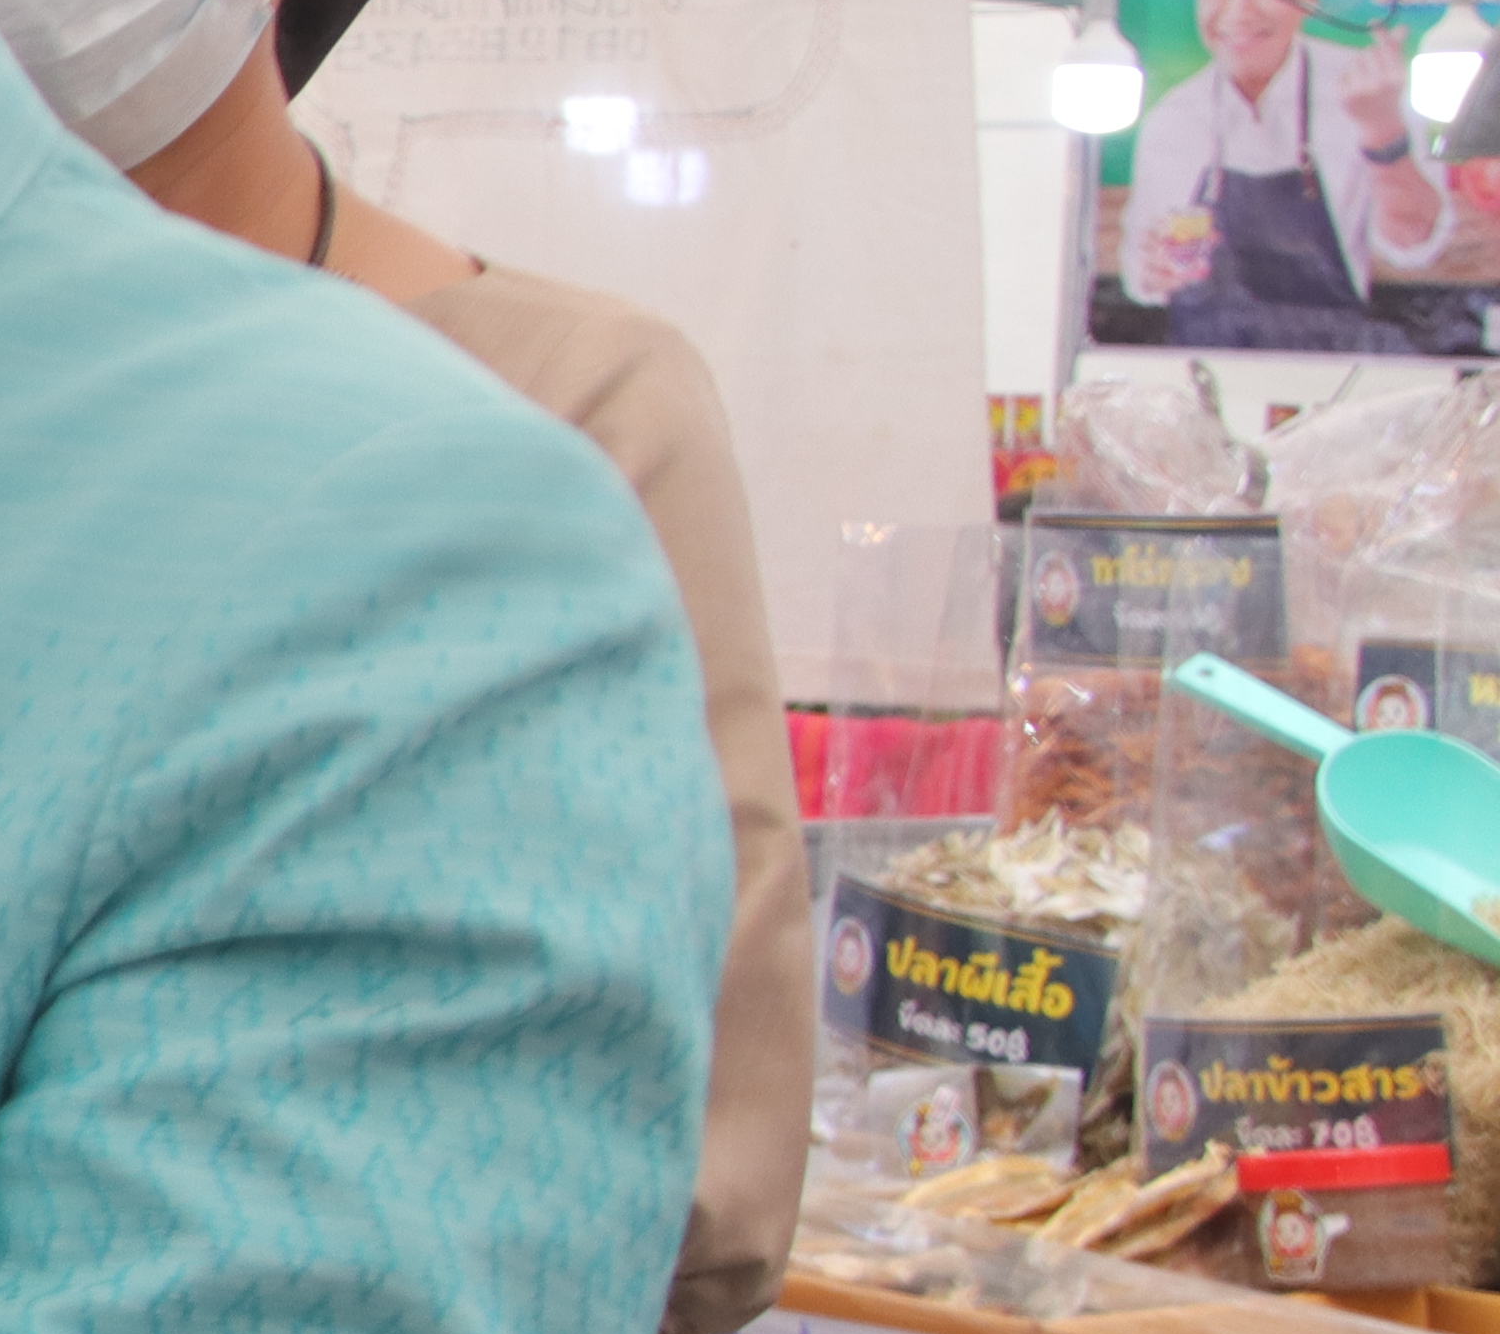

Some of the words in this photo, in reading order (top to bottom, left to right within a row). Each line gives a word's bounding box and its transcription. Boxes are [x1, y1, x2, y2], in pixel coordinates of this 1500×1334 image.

[886, 934, 1075, 1019] ปลาผีเสื้อ
[1201, 1052, 1422, 1103] ปลาข้าวสาร
